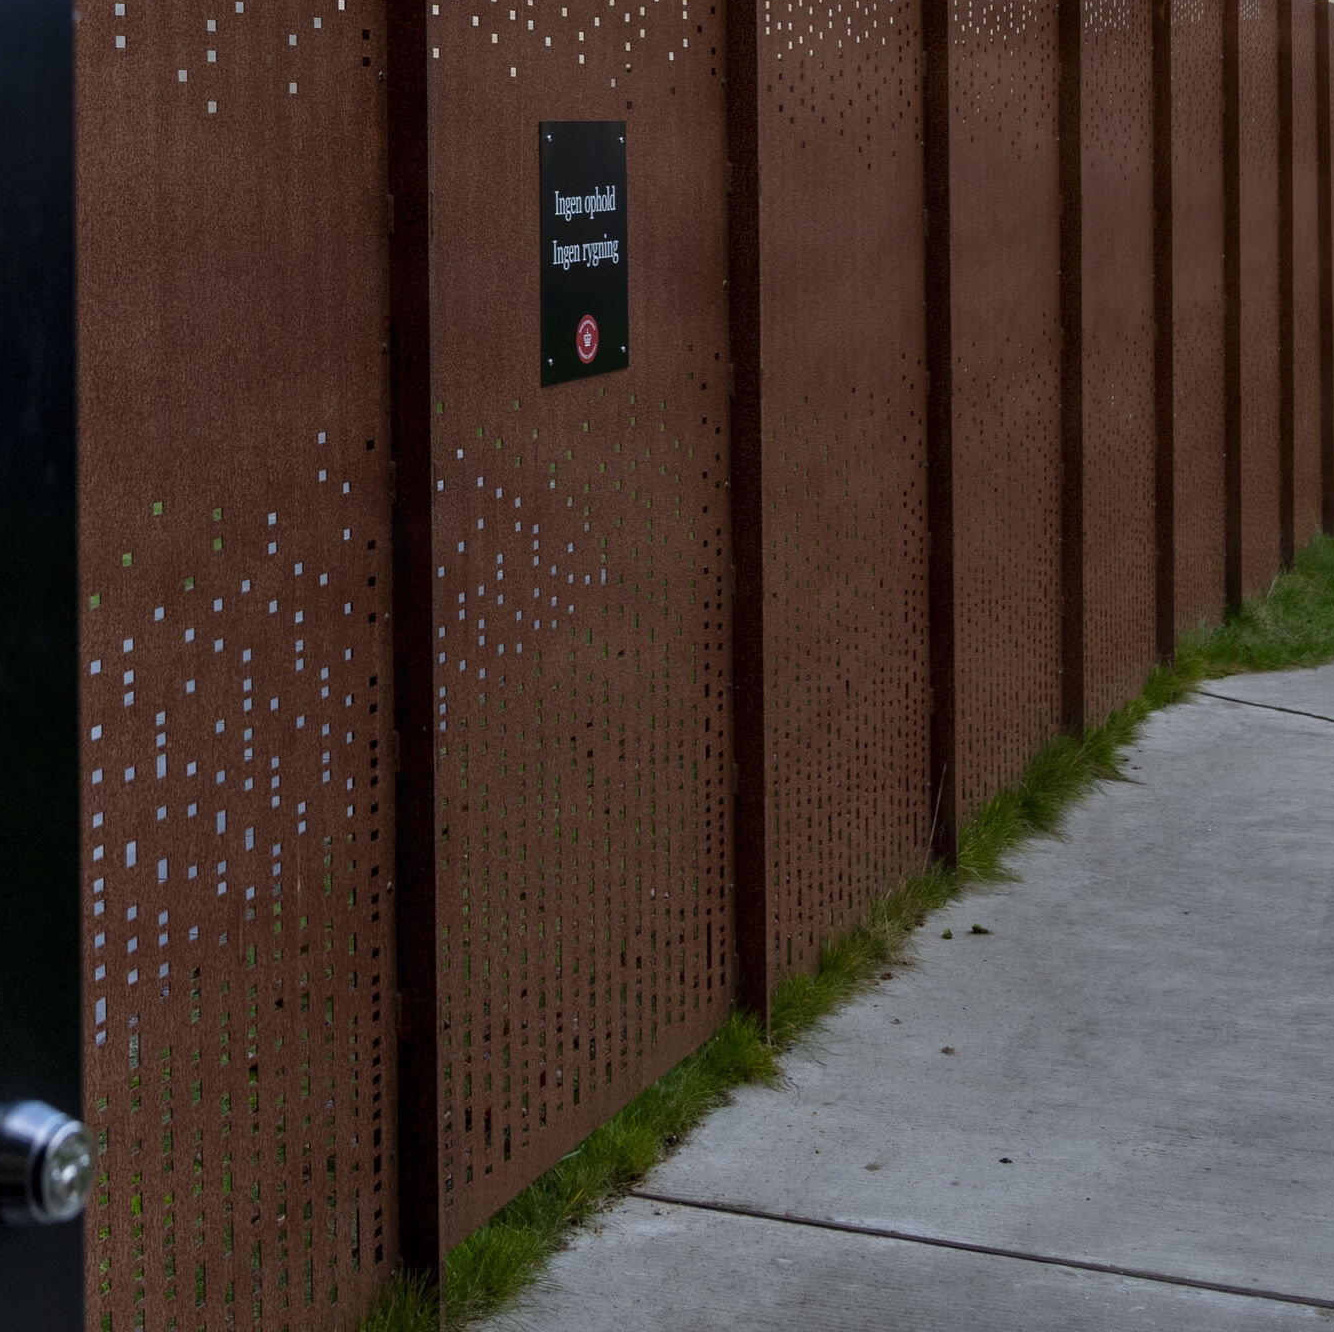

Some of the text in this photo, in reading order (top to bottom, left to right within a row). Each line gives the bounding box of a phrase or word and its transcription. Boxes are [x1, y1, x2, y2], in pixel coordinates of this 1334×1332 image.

[554, 185, 616, 221] Ingen ophold
[552, 233, 619, 270] Ingen rygning
